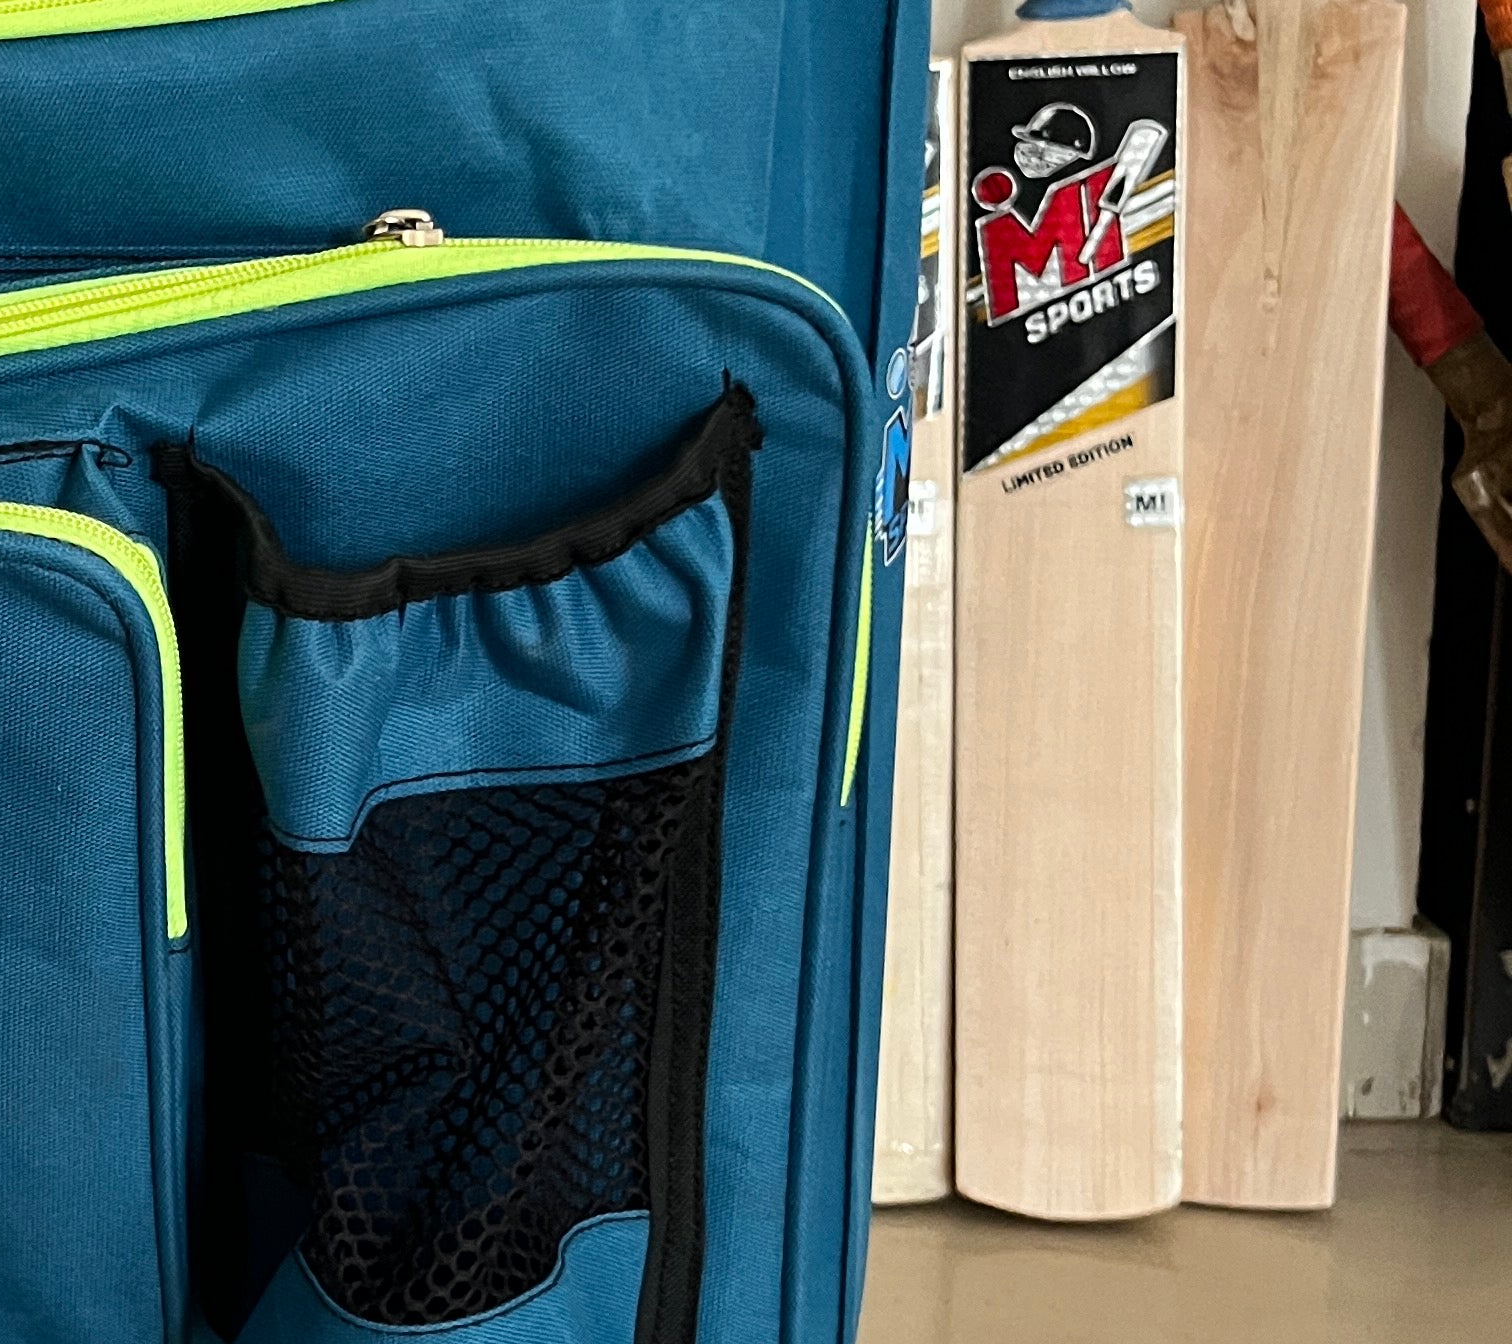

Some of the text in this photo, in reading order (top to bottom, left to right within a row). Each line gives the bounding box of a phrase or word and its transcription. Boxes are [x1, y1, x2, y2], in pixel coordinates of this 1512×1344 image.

[1025, 260, 1160, 344] SPORTS
[1002, 434, 1134, 493] LIMITED EDITION
[1134, 493, 1166, 513] MI
